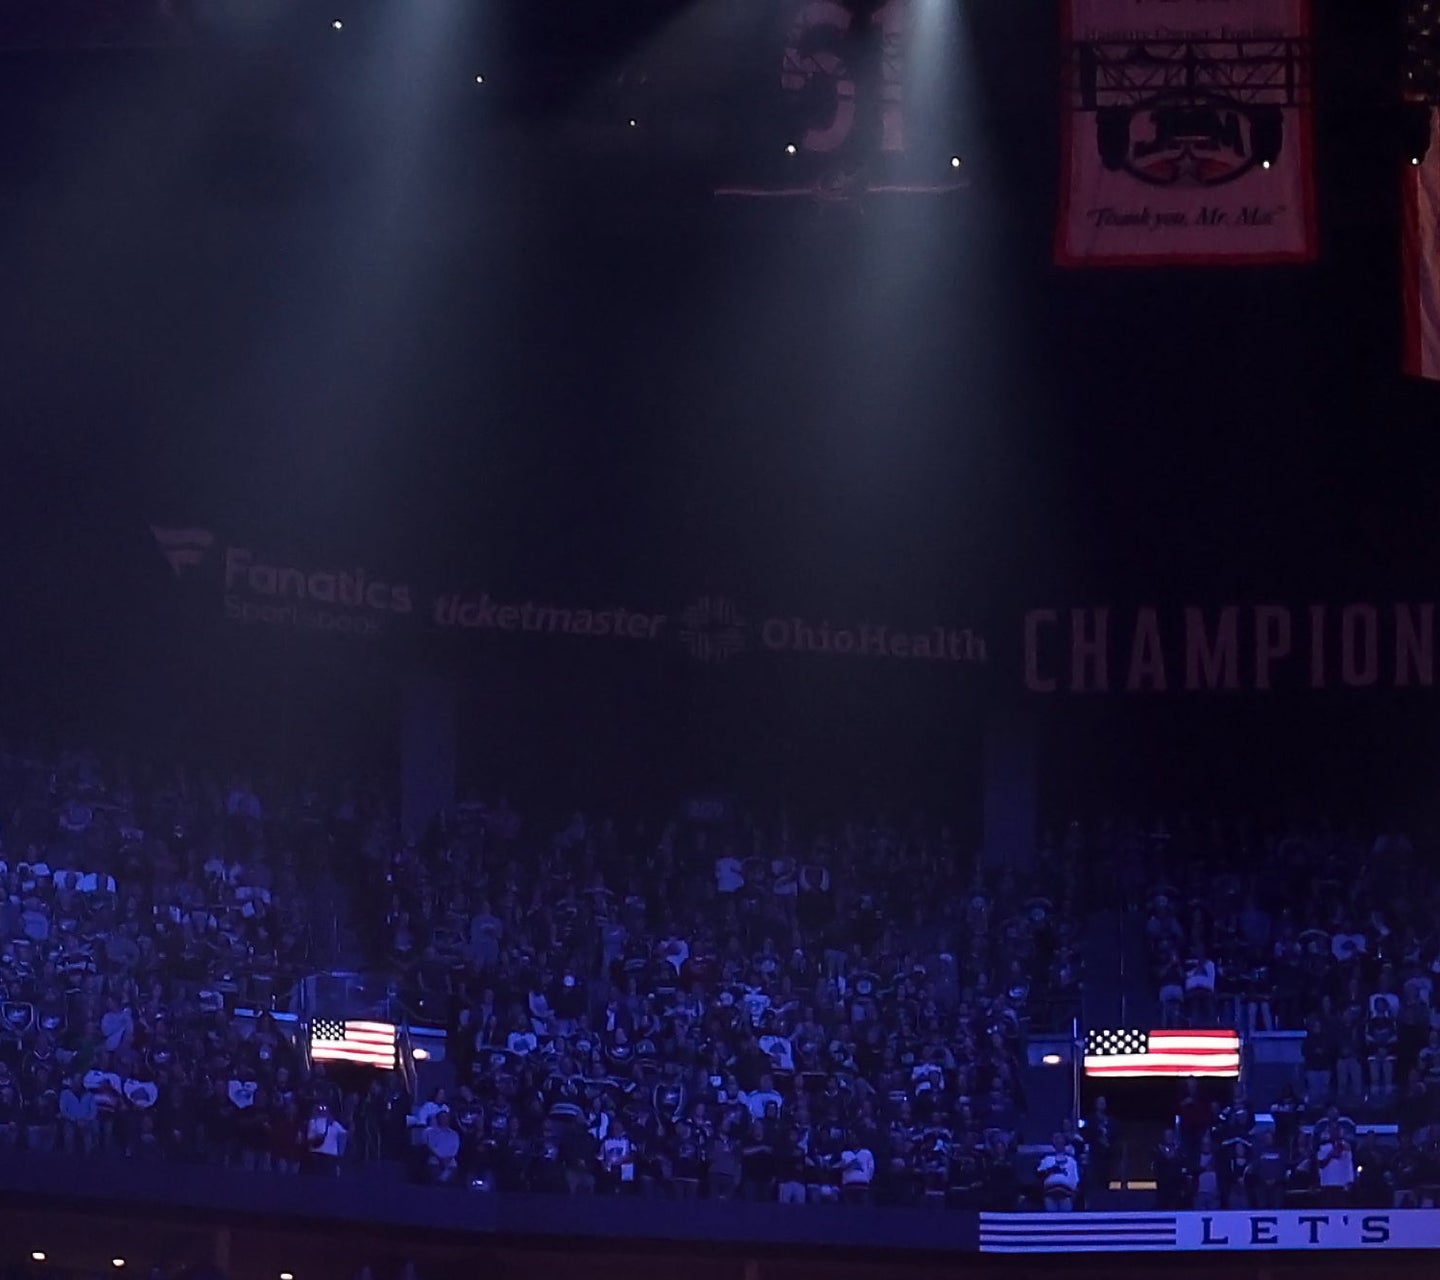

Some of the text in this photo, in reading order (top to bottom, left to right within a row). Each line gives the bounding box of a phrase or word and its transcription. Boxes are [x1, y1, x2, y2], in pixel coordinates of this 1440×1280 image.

[224, 546, 412, 613] Fanatics
[433, 593, 669, 641] ticketmaster
[762, 615, 988, 663] OhioHealth
[1200, 1214, 1391, 1247] LET'S
